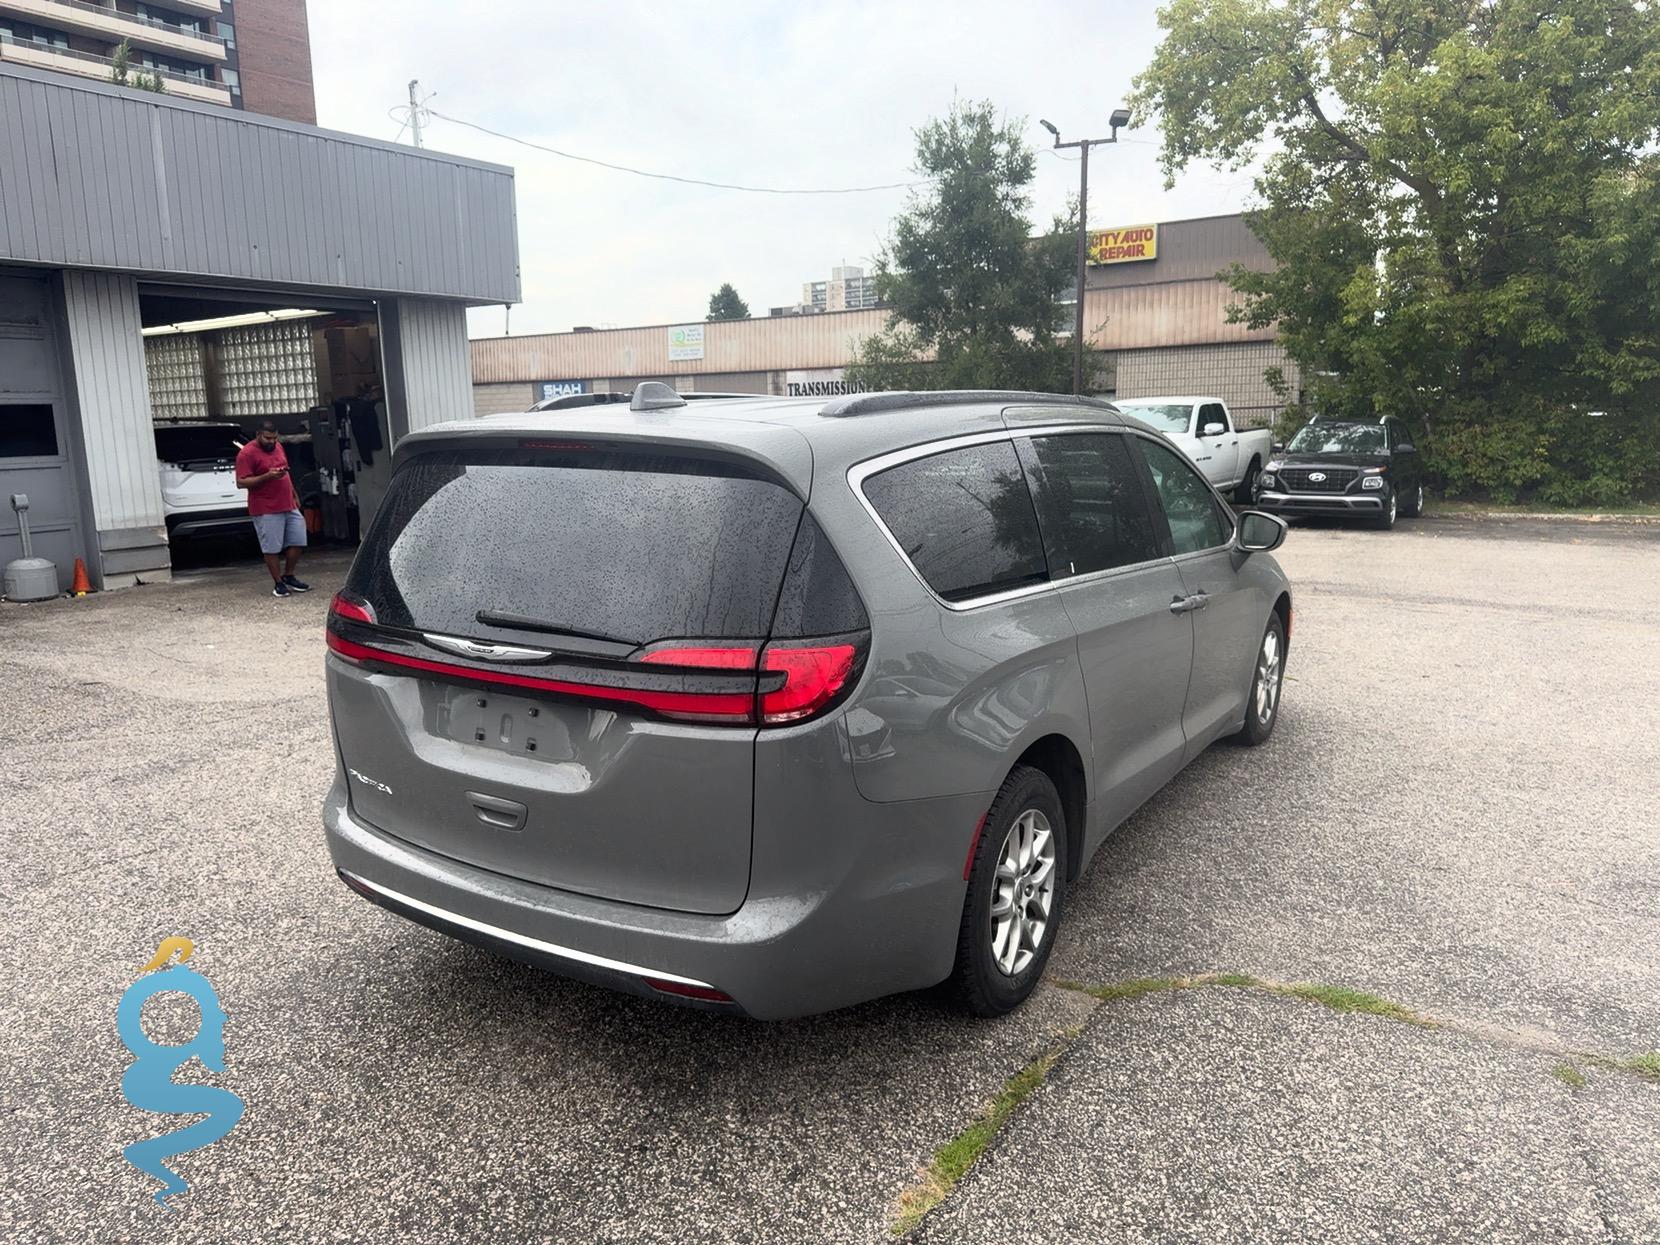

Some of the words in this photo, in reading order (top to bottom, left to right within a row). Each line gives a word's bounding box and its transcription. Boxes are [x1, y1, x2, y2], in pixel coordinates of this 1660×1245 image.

[1091, 232, 1120, 248] CITY
[1120, 228, 1153, 243] AUTO
[1099, 244, 1145, 260] REPAIR
[543, 383, 582, 395] SHAH
